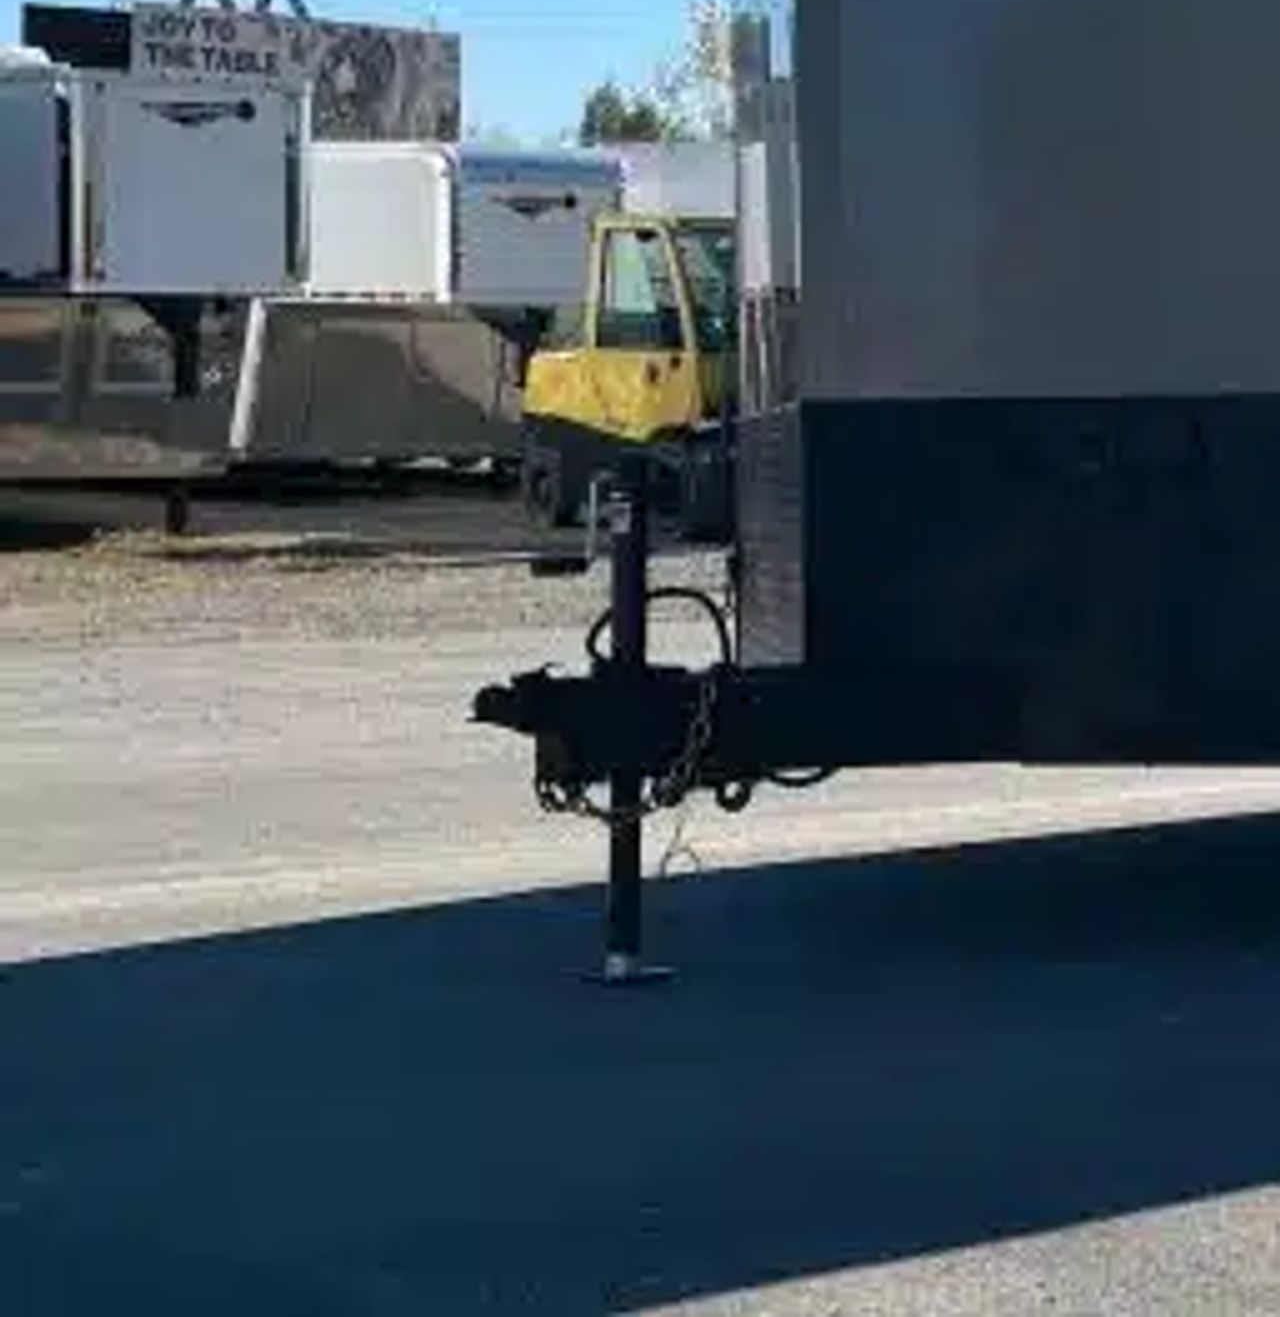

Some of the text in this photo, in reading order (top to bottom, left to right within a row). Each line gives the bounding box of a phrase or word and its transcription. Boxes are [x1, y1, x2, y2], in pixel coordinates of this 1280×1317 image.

[141, 11, 237, 43] JOY TO
[145, 42, 277, 78] THE TABLE
